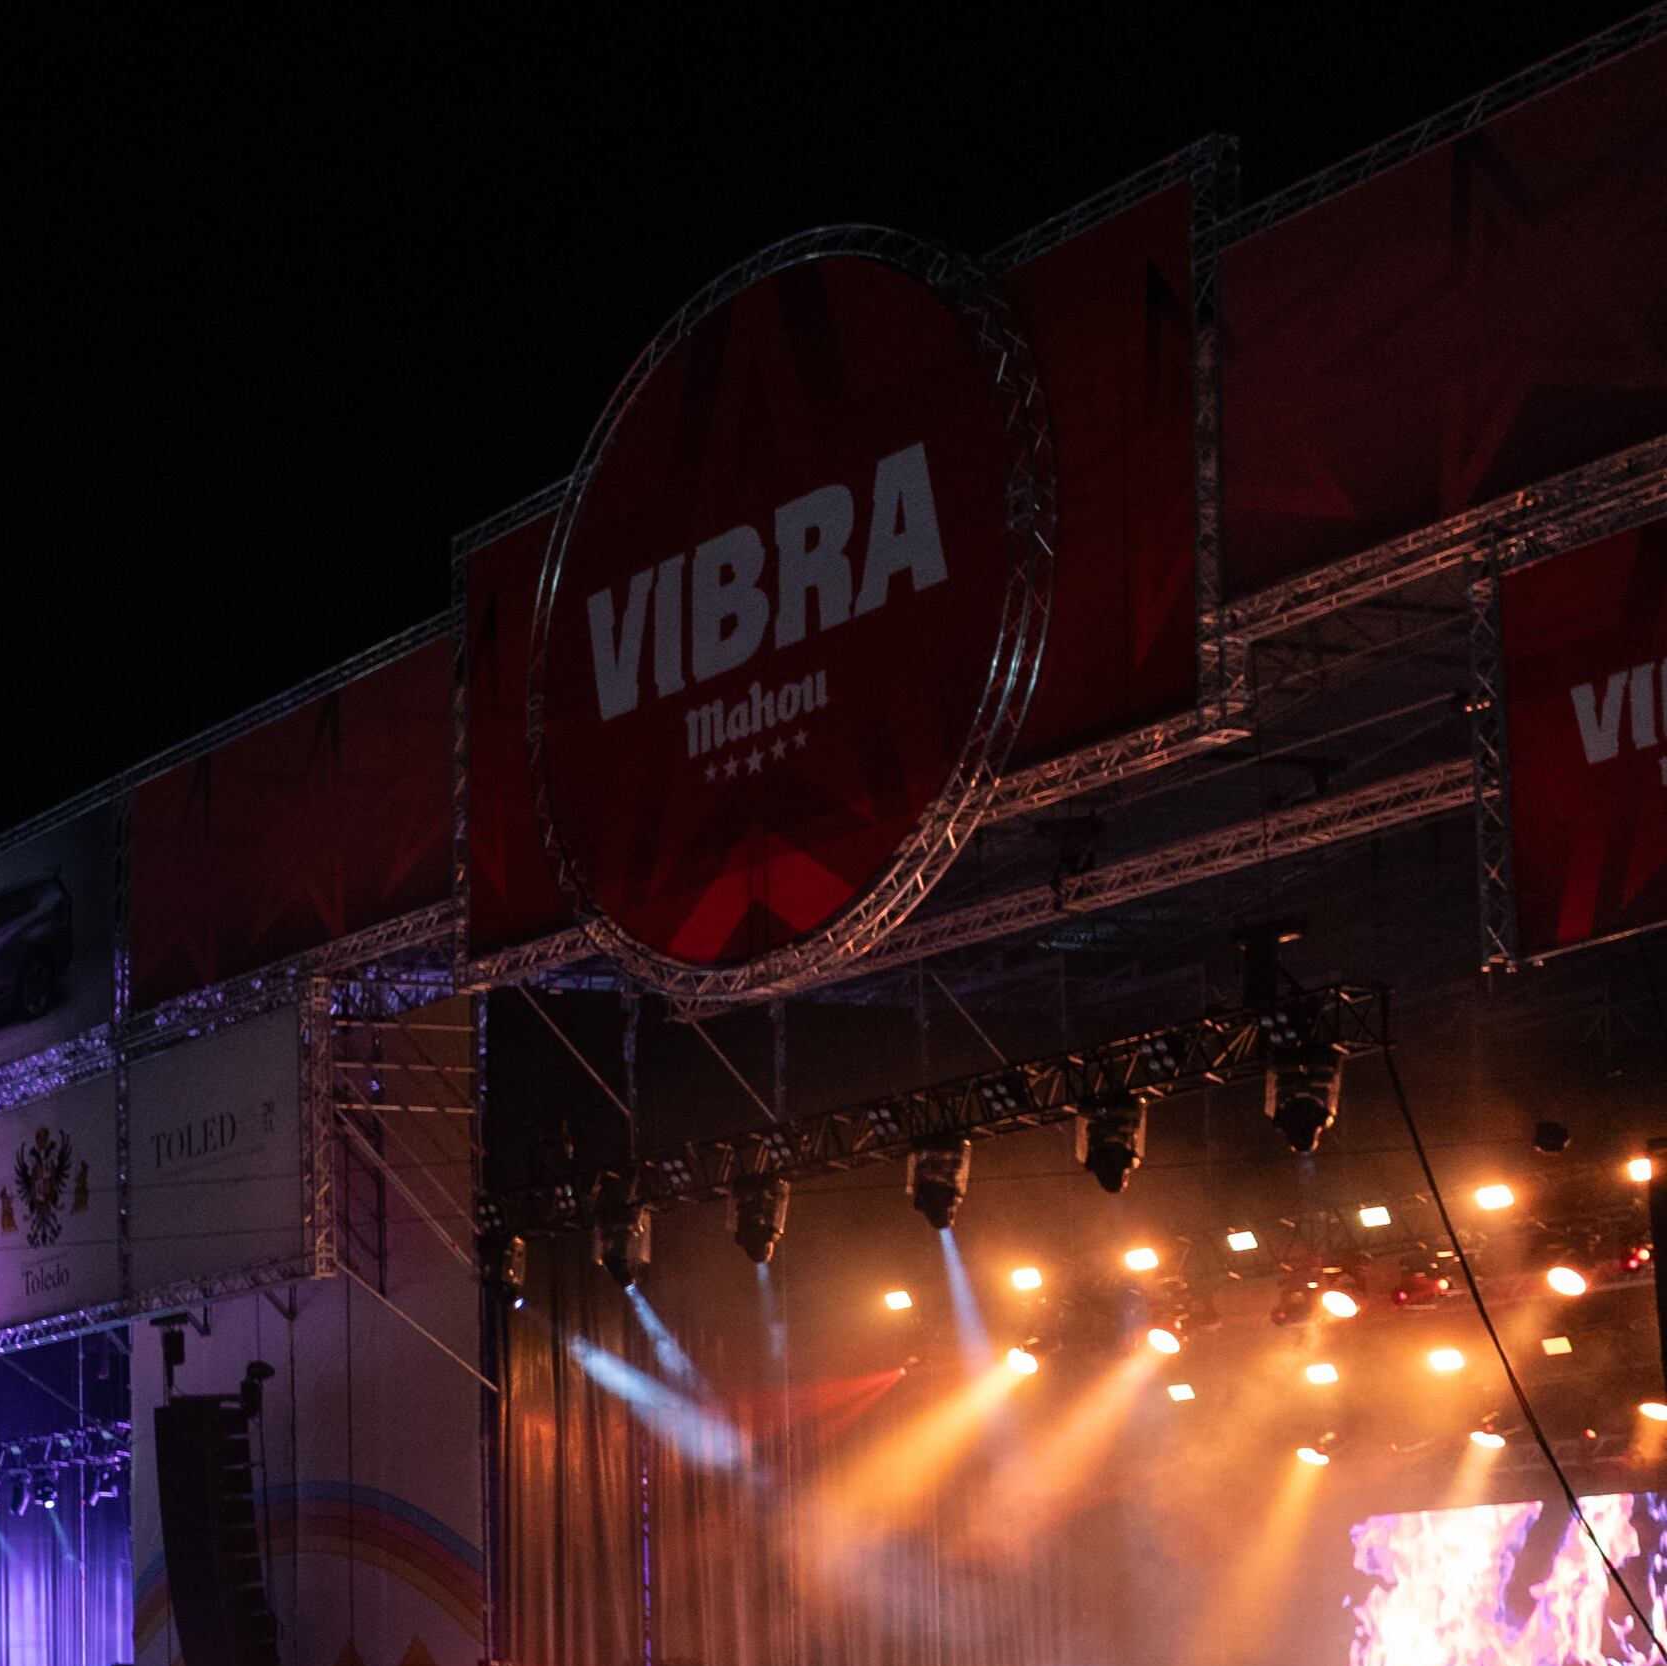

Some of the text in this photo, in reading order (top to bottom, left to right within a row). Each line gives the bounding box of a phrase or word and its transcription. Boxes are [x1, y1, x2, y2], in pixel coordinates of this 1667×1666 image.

[586, 440, 950, 722] VIBRA
[685, 669, 830, 760] Mahou
[1569, 656, 1667, 766] VI
